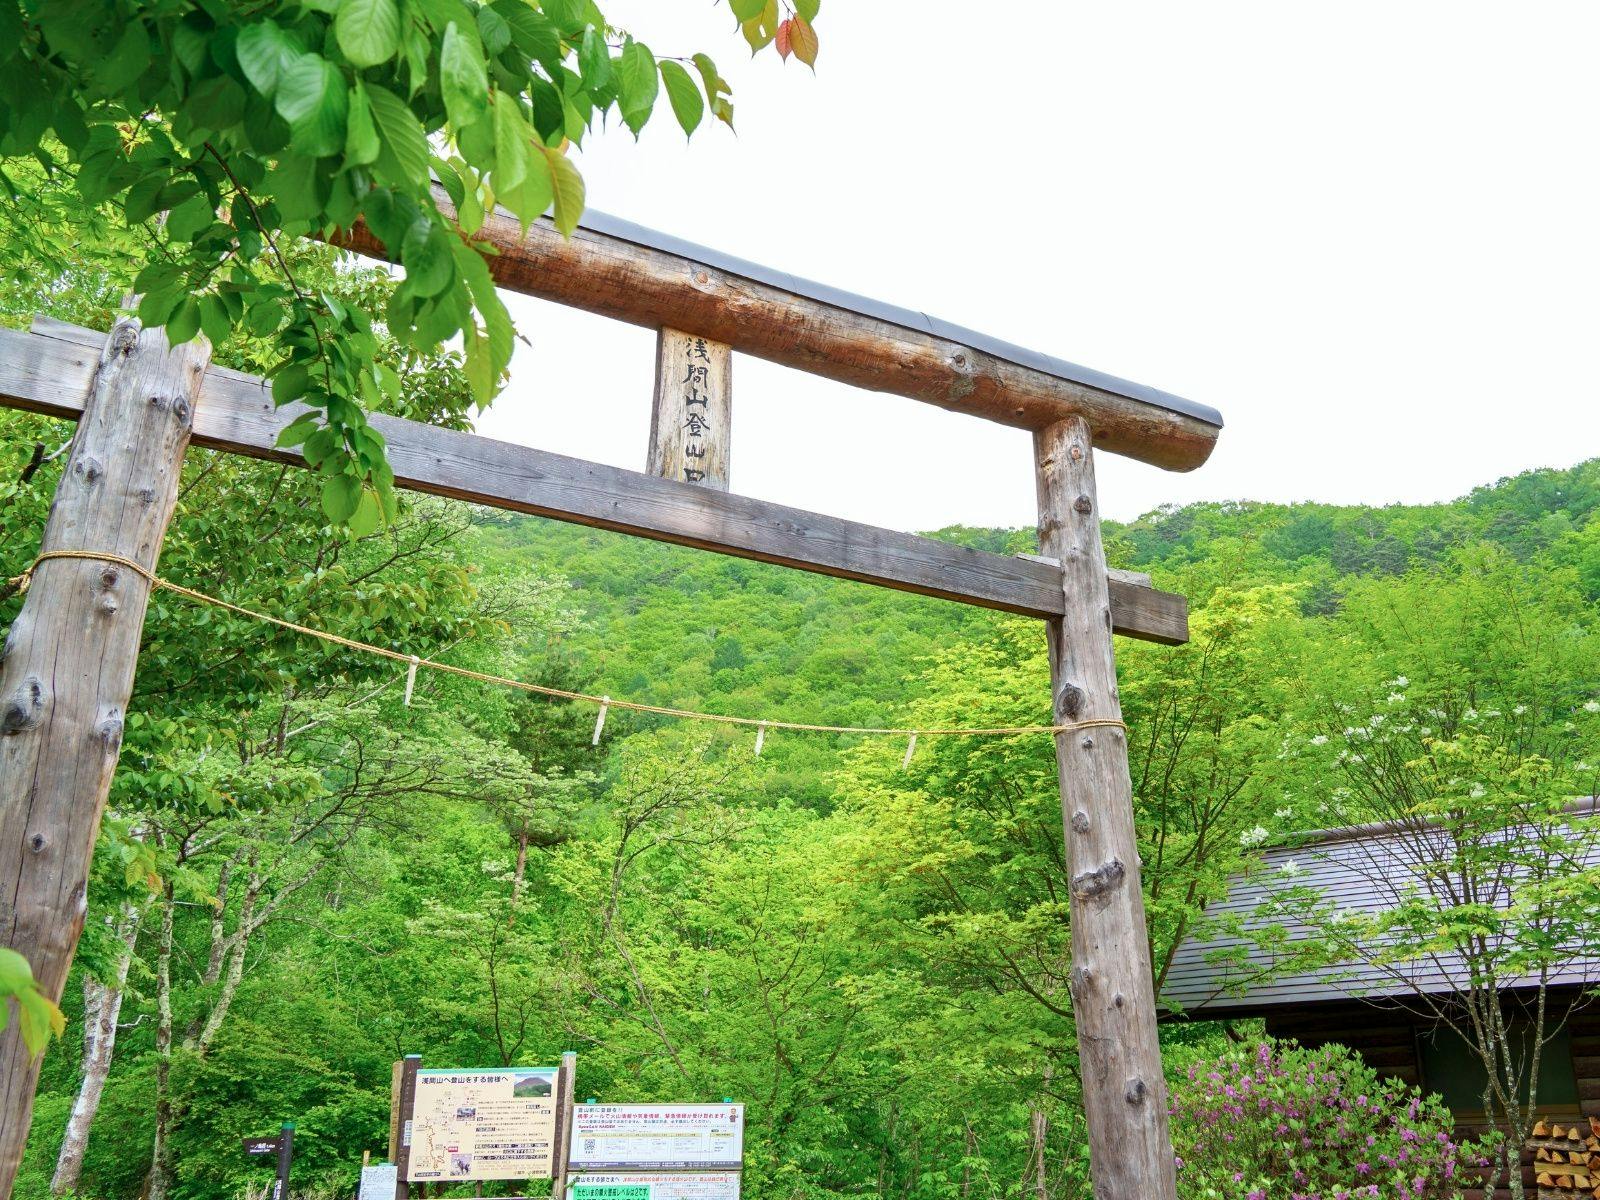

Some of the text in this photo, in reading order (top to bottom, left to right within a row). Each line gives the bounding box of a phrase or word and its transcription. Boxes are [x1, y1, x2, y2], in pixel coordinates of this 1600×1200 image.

[683, 337, 710, 482] 浅間山登山口
